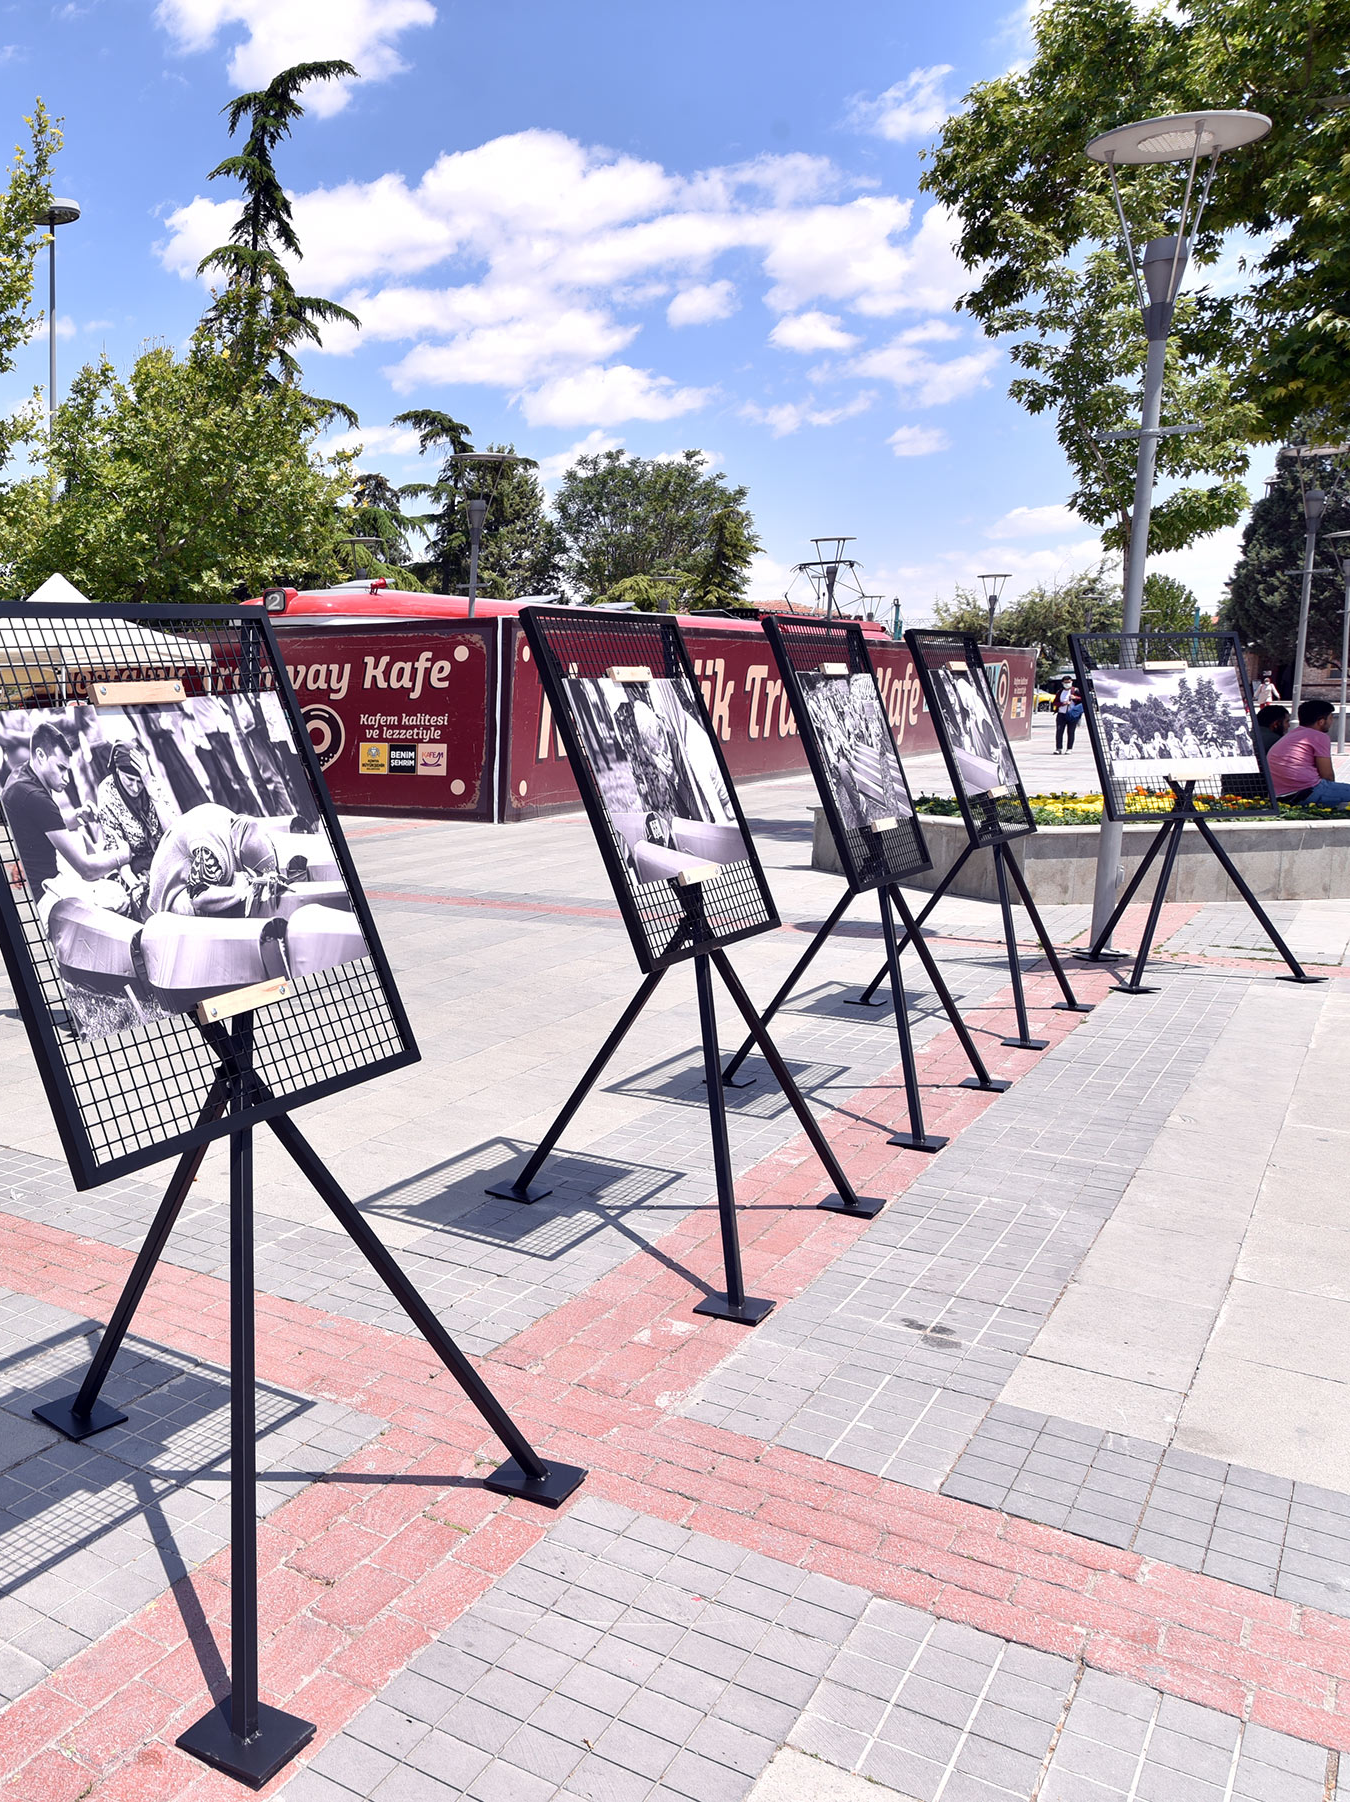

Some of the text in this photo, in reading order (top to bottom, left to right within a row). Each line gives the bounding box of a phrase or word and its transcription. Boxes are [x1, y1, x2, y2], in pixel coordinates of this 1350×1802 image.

[268, 593, 280, 610] 2
[363, 651, 452, 699] Kafe
[359, 713, 449, 728] Kafem kalitesi
[365, 727, 442, 742] ve lezzetiyle
